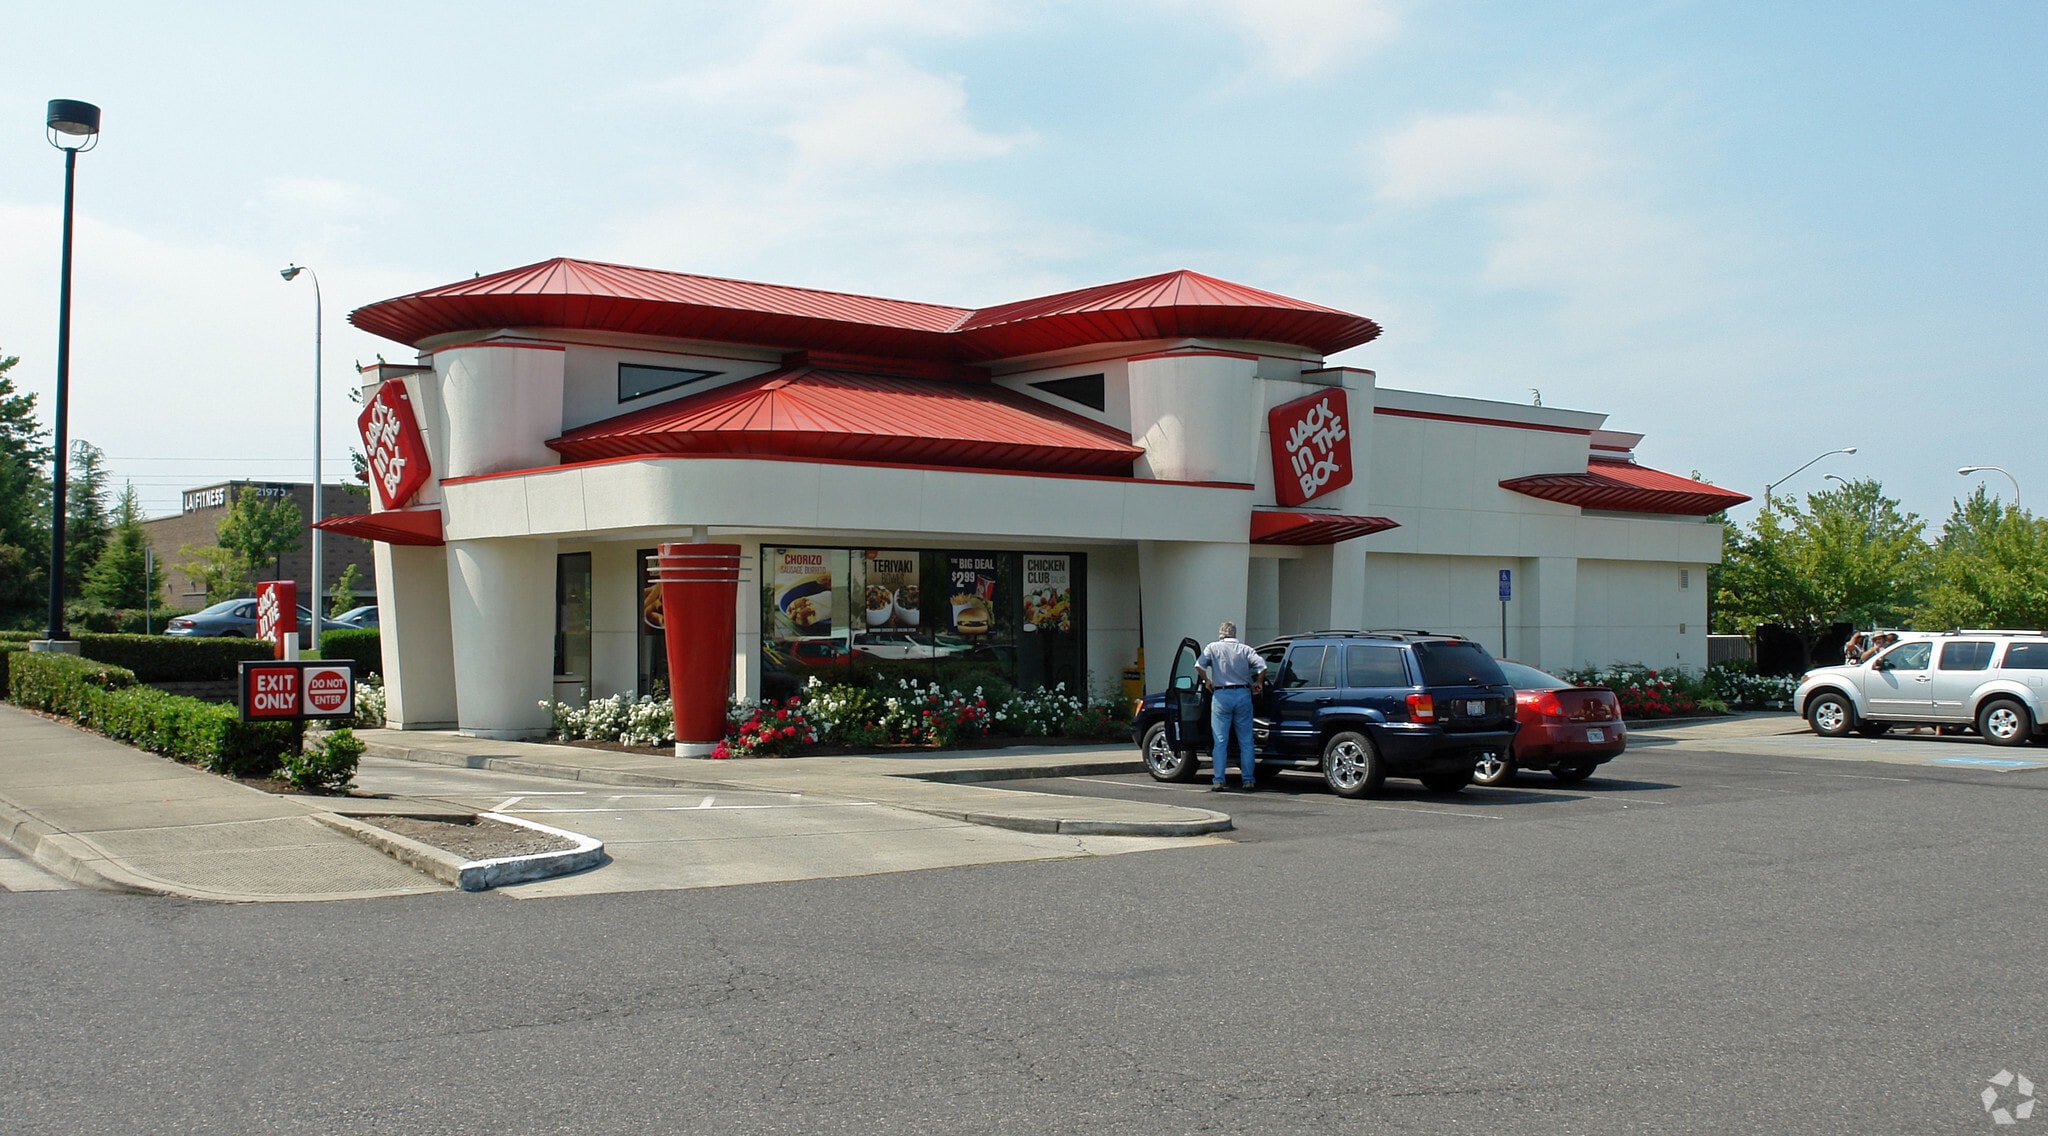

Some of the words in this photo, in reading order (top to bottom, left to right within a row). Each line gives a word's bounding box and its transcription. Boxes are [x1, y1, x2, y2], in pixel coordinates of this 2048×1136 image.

[366, 394, 388, 456] JACK
[1286, 398, 1333, 452] JACK
[374, 446, 389, 479] IN
[382, 408, 400, 451] THE
[1291, 446, 1314, 477] IN
[1312, 416, 1346, 454] THE
[384, 446, 406, 499] BOX
[1300, 451, 1339, 499] BOX
[185, 492, 194, 511] LA
[195, 488, 225, 510] FITNESS
[784, 554, 822, 565] CHORIZO
[873, 560, 912, 573] TERIYAKI
[959, 558, 973, 569] BIG
[974, 559, 994, 569] DEAL
[1028, 560, 1065, 571] CHICKEN
[780, 566, 803, 574] SAUSAGE
[1028, 572, 1050, 583] CLUB
[258, 584, 276, 616] JACK
[260, 615, 268, 636] IN
[267, 601, 280, 627] THE
[257, 674, 294, 692] EXIT
[312, 679, 325, 688] DO
[326, 678, 344, 688] NOT
[254, 693, 296, 710] ONLY
[315, 695, 341, 705] ENTER
